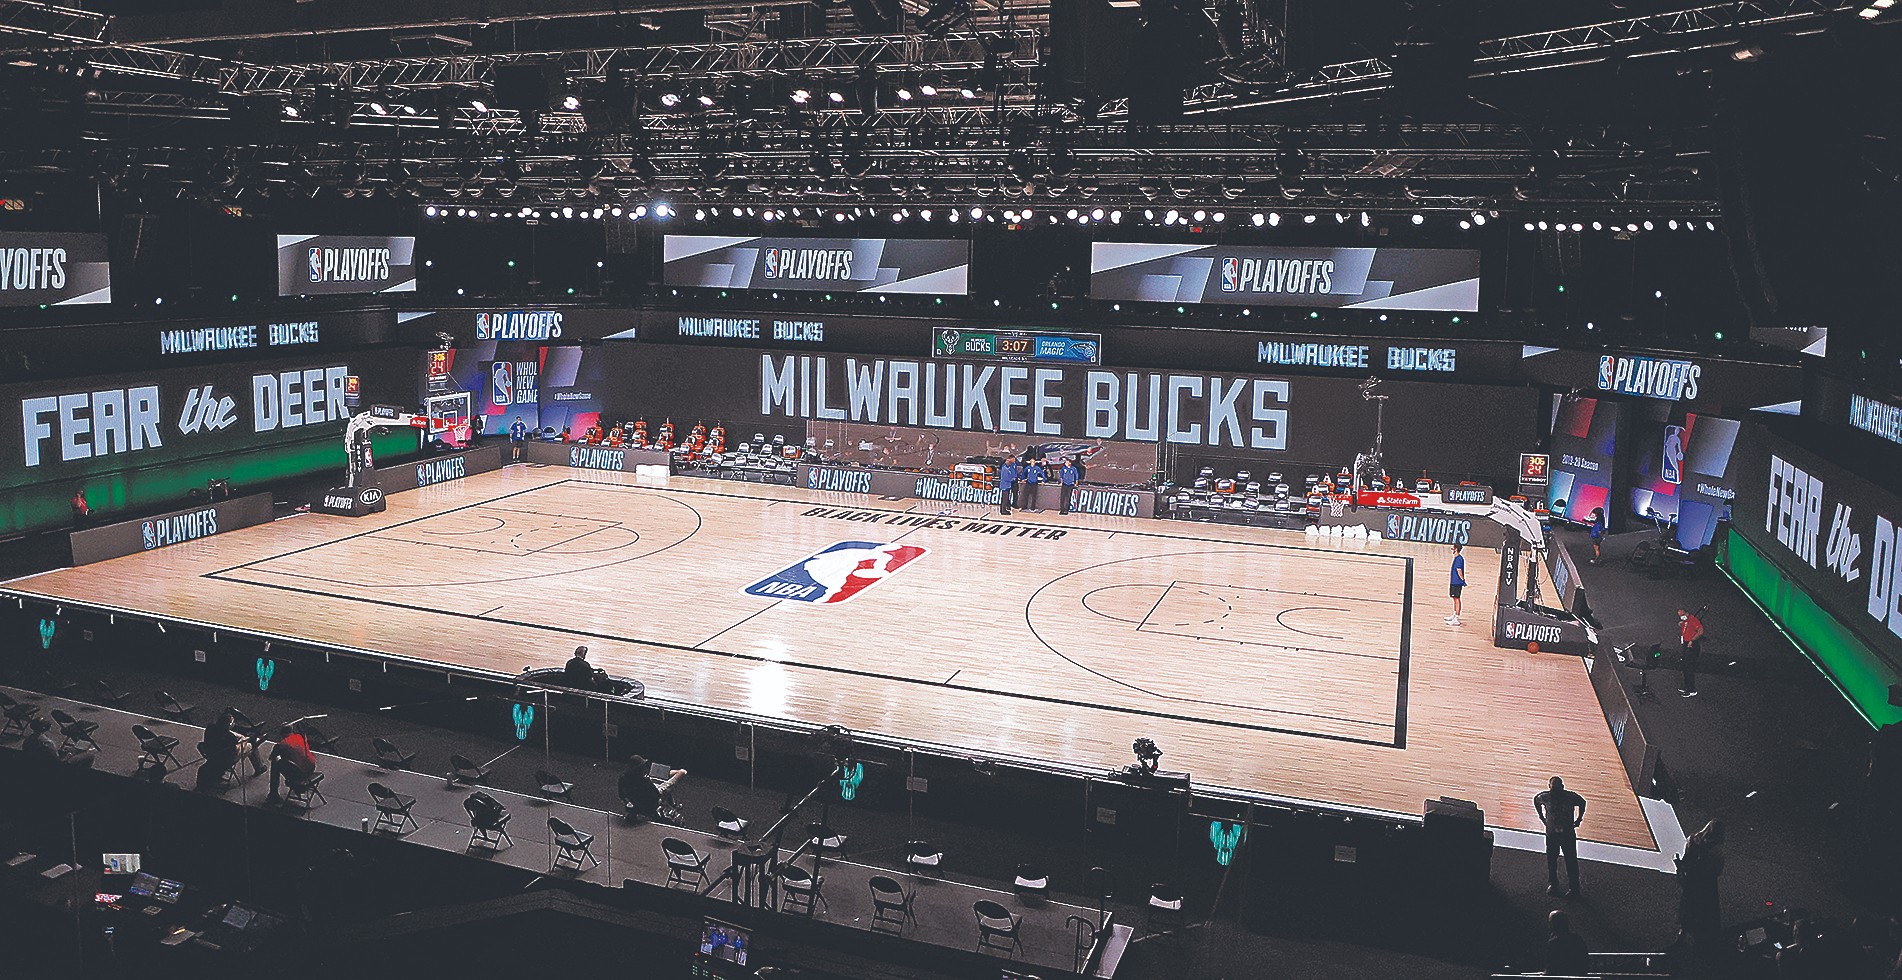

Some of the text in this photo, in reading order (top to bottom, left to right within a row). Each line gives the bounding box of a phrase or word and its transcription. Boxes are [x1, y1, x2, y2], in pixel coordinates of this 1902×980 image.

[323, 248, 390, 281] PLAYOFFS
[778, 249, 853, 280] PLAYOFFS
[1239, 258, 1334, 294] PLAYOFFS
[160, 321, 319, 355] MILWAUKEE BUCKS
[490, 312, 563, 339] PLAYOFFS
[678, 317, 824, 342] MILWAUKEE BUCKS
[965, 341, 991, 352] BUCKS
[1002, 340, 1028, 352] 3:07
[1040, 347, 1064, 355] MAGIC
[1257, 341, 1456, 372] MILWAUKEE BUCKS
[516, 376, 534, 389] NEW
[1613, 357, 1700, 400] PLAYOFFS
[516, 390, 538, 404] GAME
[760, 352, 1290, 451] MILWAUKEE BUCKS
[22, 365, 350, 467] FEAR the DEER
[425, 457, 465, 485] PLAYOFFS
[579, 447, 624, 470] PLAYOFFS
[363, 491, 379, 501] KIA
[818, 471, 870, 494] PLAYOFFS
[1455, 490, 1485, 502] PLAYOFFS
[1078, 489, 1138, 517] PLAYOFFS
[157, 508, 217, 547] PLAYOFFS
[801, 508, 1067, 541] BLACK LIVES MATTER
[1400, 516, 1471, 544] PLAYOFFS
[1766, 454, 1823, 569] FEAR
[1826, 502, 1861, 582] the
[1505, 547, 1514, 586] NBA TV
[755, 580, 819, 599] NBA
[1515, 623, 1562, 643] PLAYOFFS
